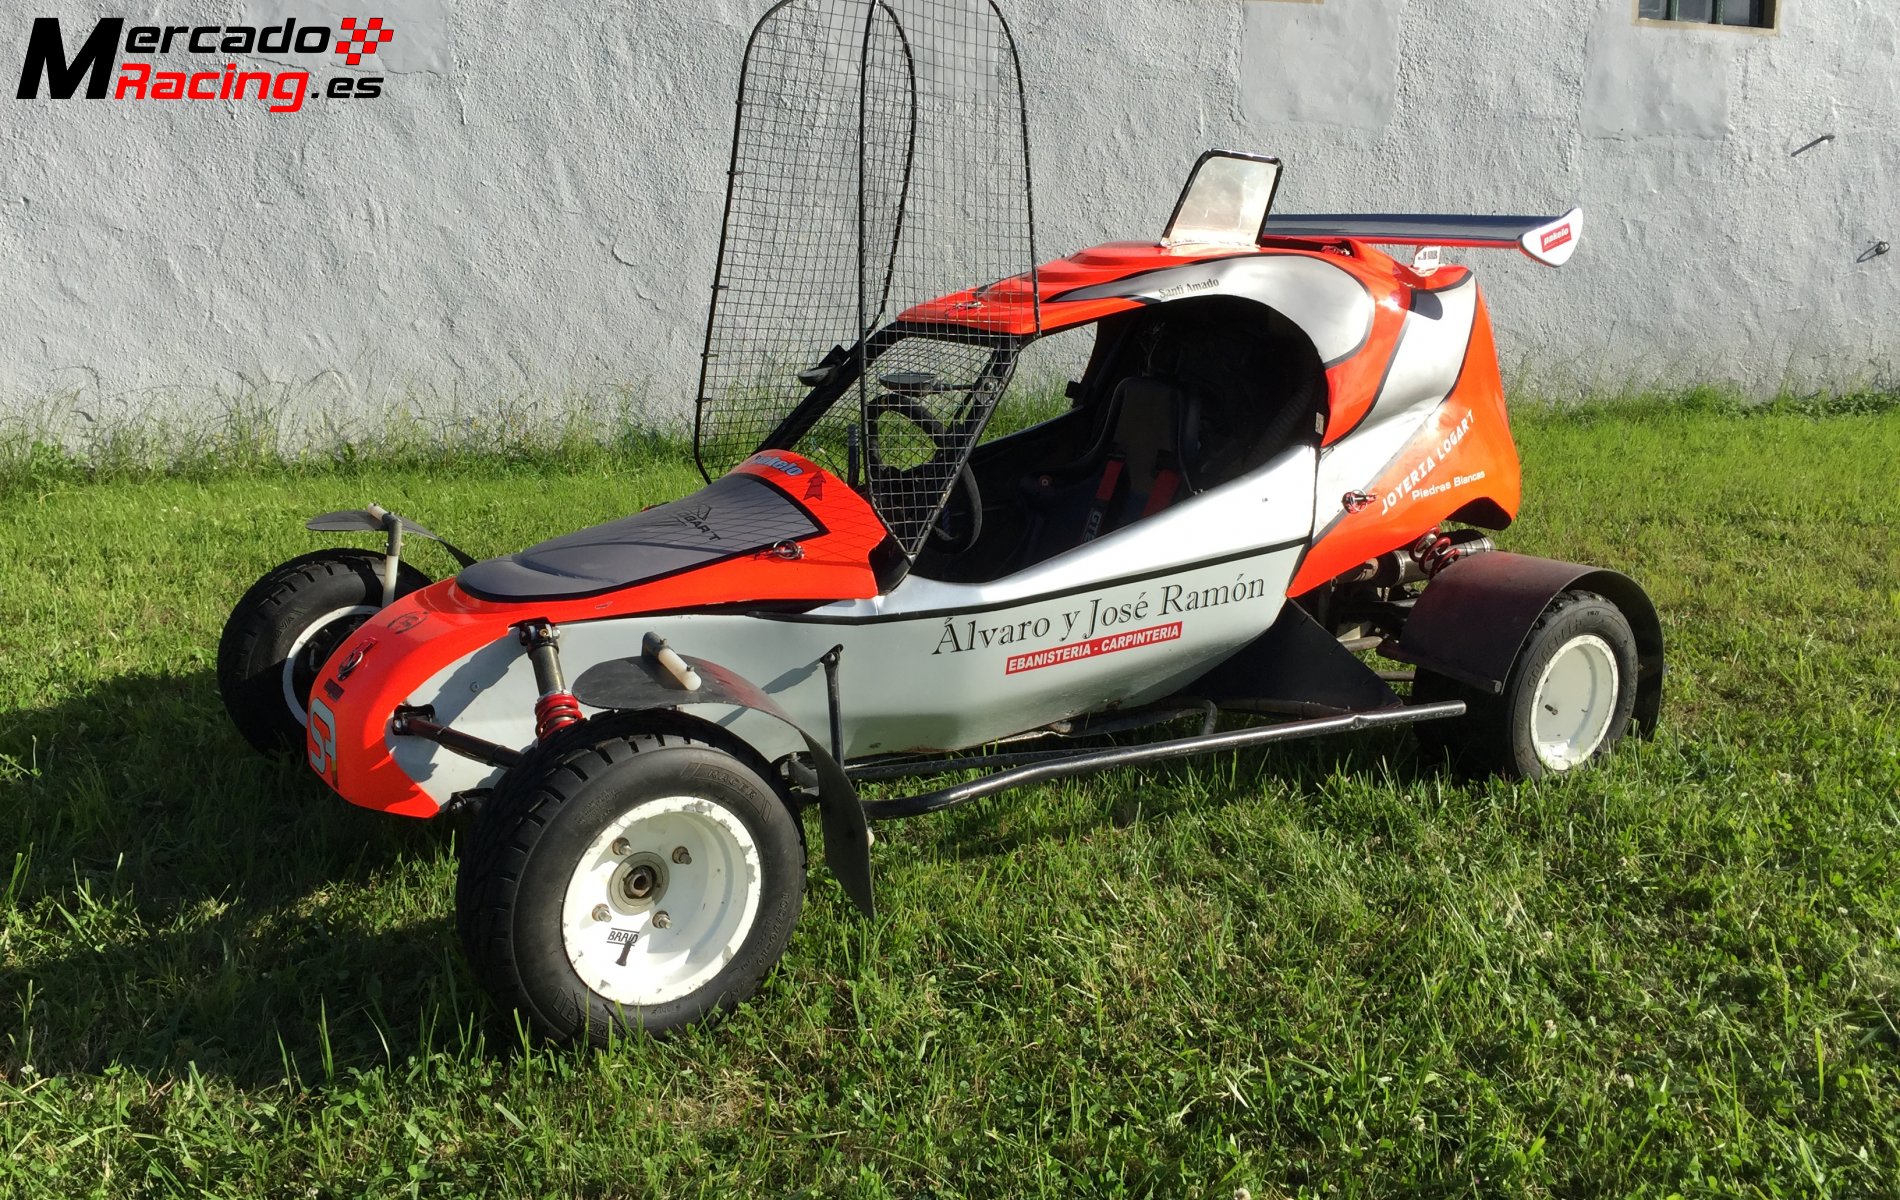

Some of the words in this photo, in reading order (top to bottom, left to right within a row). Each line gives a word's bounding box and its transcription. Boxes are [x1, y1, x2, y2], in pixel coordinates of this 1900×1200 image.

[1158, 285, 1185, 299] Santi
[1186, 278, 1220, 294] Amado
[1381, 456, 1436, 515] JOYERIA
[1411, 482, 1452, 501] Piedras
[1454, 470, 1486, 487] Blancas
[931, 616, 1051, 655] Álvaro
[1059, 609, 1082, 642] y
[1083, 593, 1149, 639] José
[1157, 573, 1266, 616] Ramón
[1008, 644, 1092, 673] EBANISTERIA
[1100, 624, 1180, 653] CARPINTERIA
